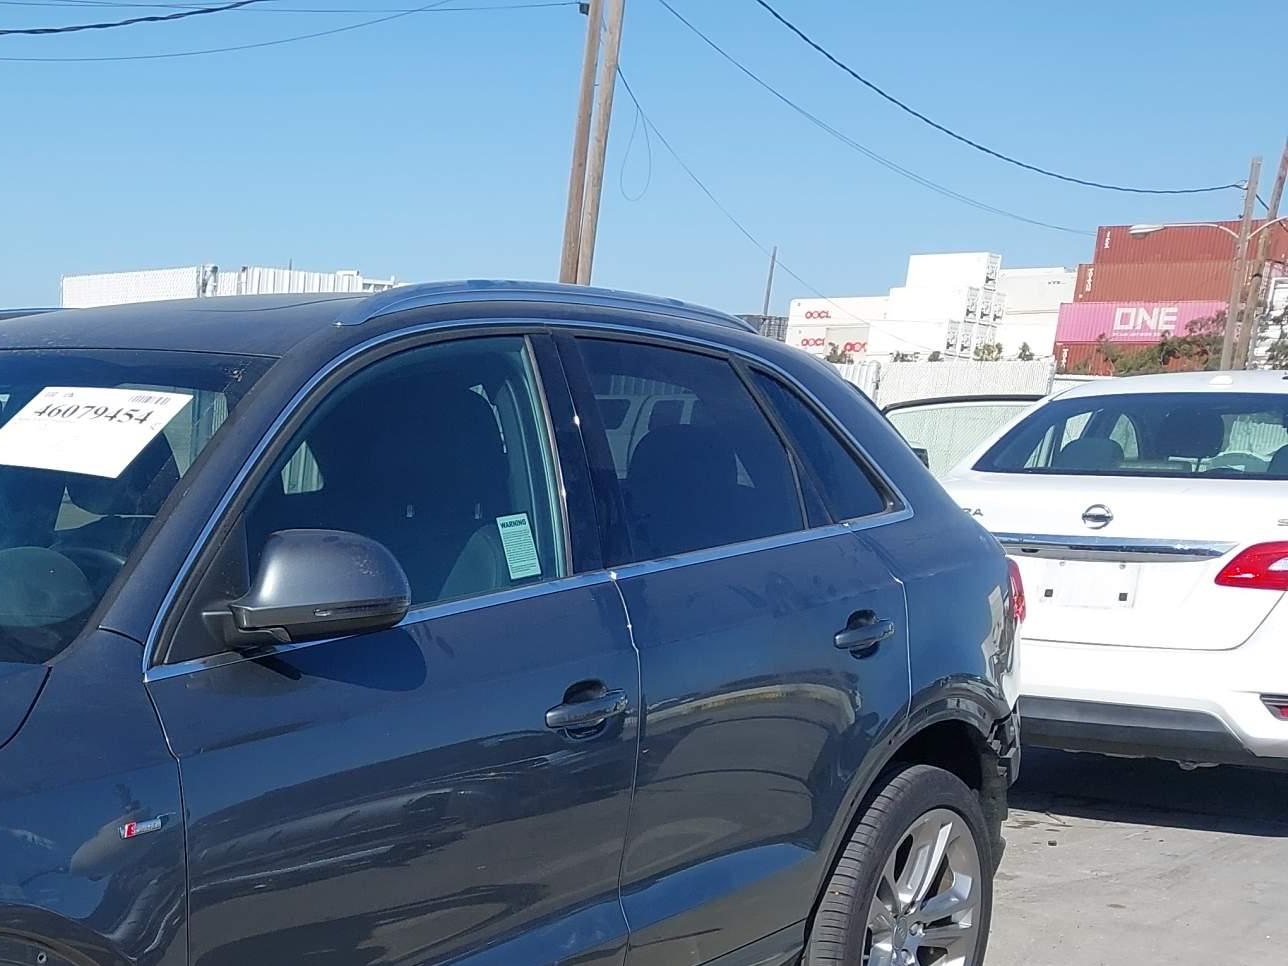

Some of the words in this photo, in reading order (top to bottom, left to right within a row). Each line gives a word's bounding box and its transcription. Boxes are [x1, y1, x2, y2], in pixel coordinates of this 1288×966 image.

[805, 310, 831, 319] OOCL
[1113, 307, 1178, 330] ONE
[34, 403, 154, 424] 46079454
[500, 518, 527, 528] WARNING
